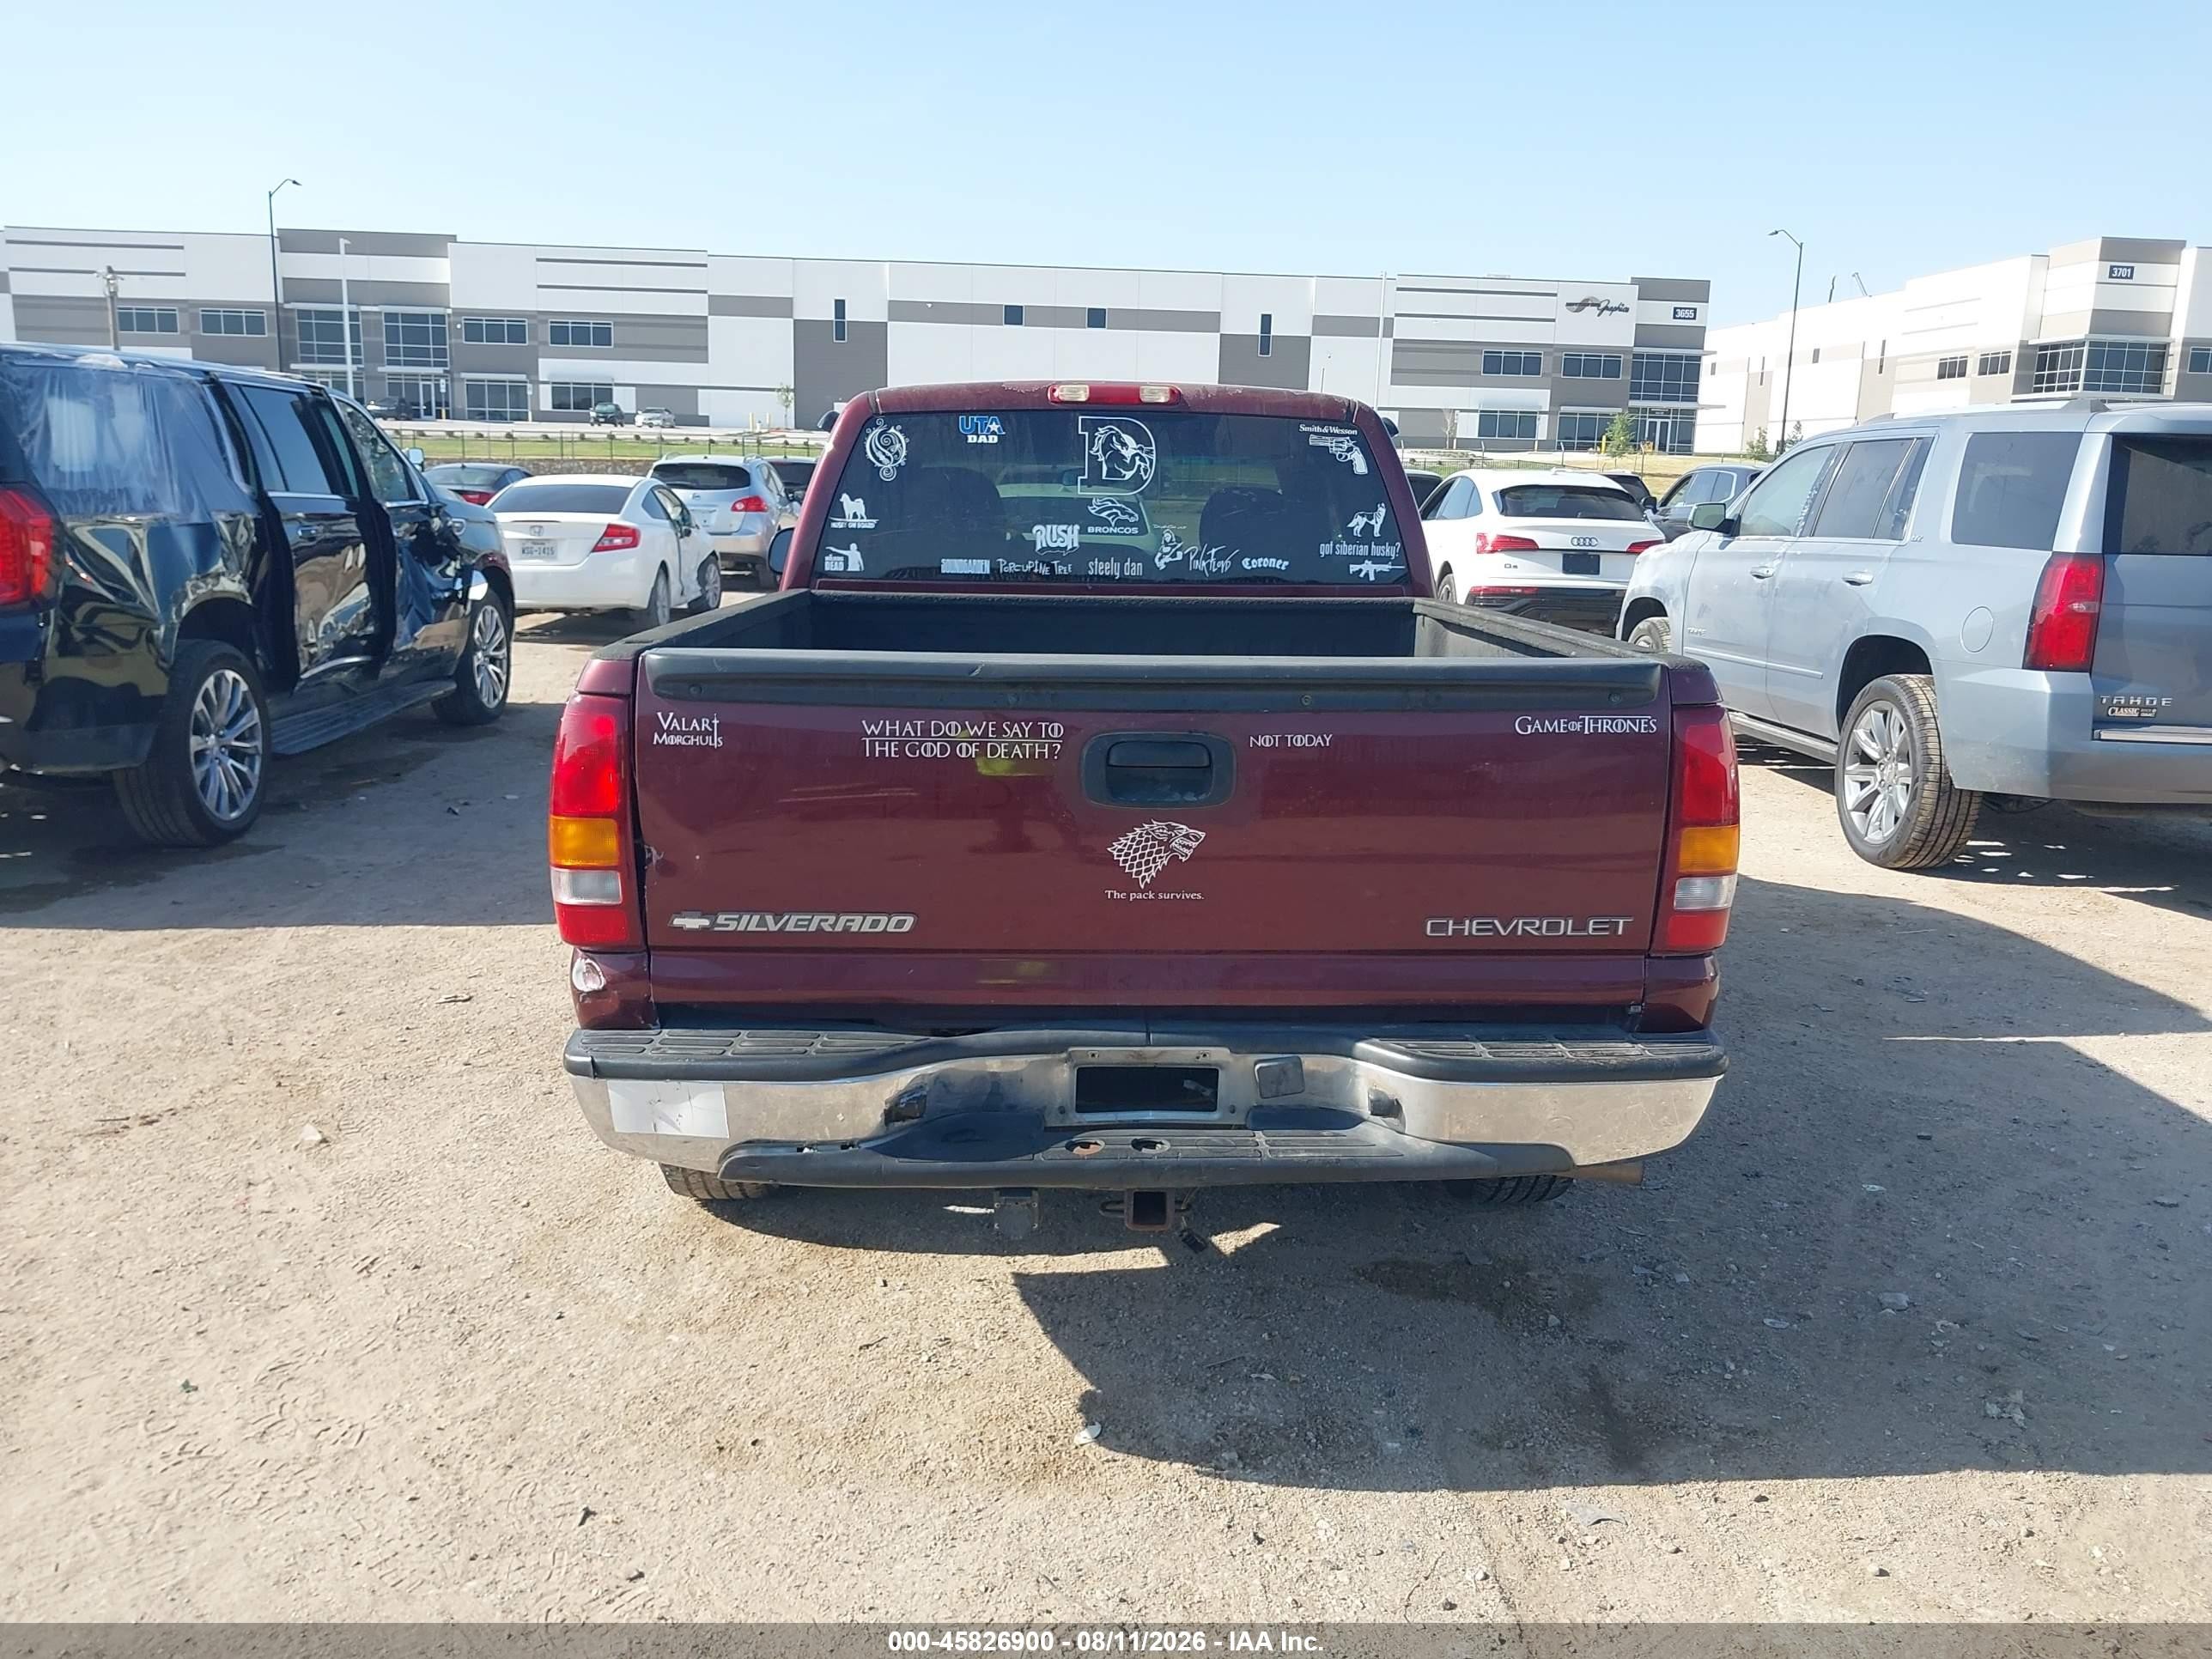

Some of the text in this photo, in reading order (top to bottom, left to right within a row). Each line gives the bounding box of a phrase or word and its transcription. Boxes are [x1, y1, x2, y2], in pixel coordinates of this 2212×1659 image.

[2112, 267, 2131, 277] 3701
[1675, 308, 1695, 319] 3655
[958, 416, 1006, 435] UTA
[967, 434, 999, 444] DAD
[1087, 526, 1139, 534] BRONCOS
[1032, 524, 1080, 554] RUSH
[1319, 540, 1401, 560] got siberian husky?
[824, 561, 845, 571] DEAD
[1088, 557, 1143, 580] steely dan
[1242, 557, 1290, 571] Coroner
[2100, 696, 2173, 707] TAHOE
[2107, 707, 2141, 717] CLASSIC
[861, 720, 1065, 738] WHAT DO WE SAY TO
[1515, 715, 1657, 735] GAME OF THRONES
[1249, 733, 1334, 748] NOT TODAY
[861, 738, 1062, 760] THE GOD OF DEATH?
[1104, 890, 1205, 902] The pack survives.
[714, 913, 916, 933] SILVERADO
[1425, 917, 1634, 937] CHEVROLET
